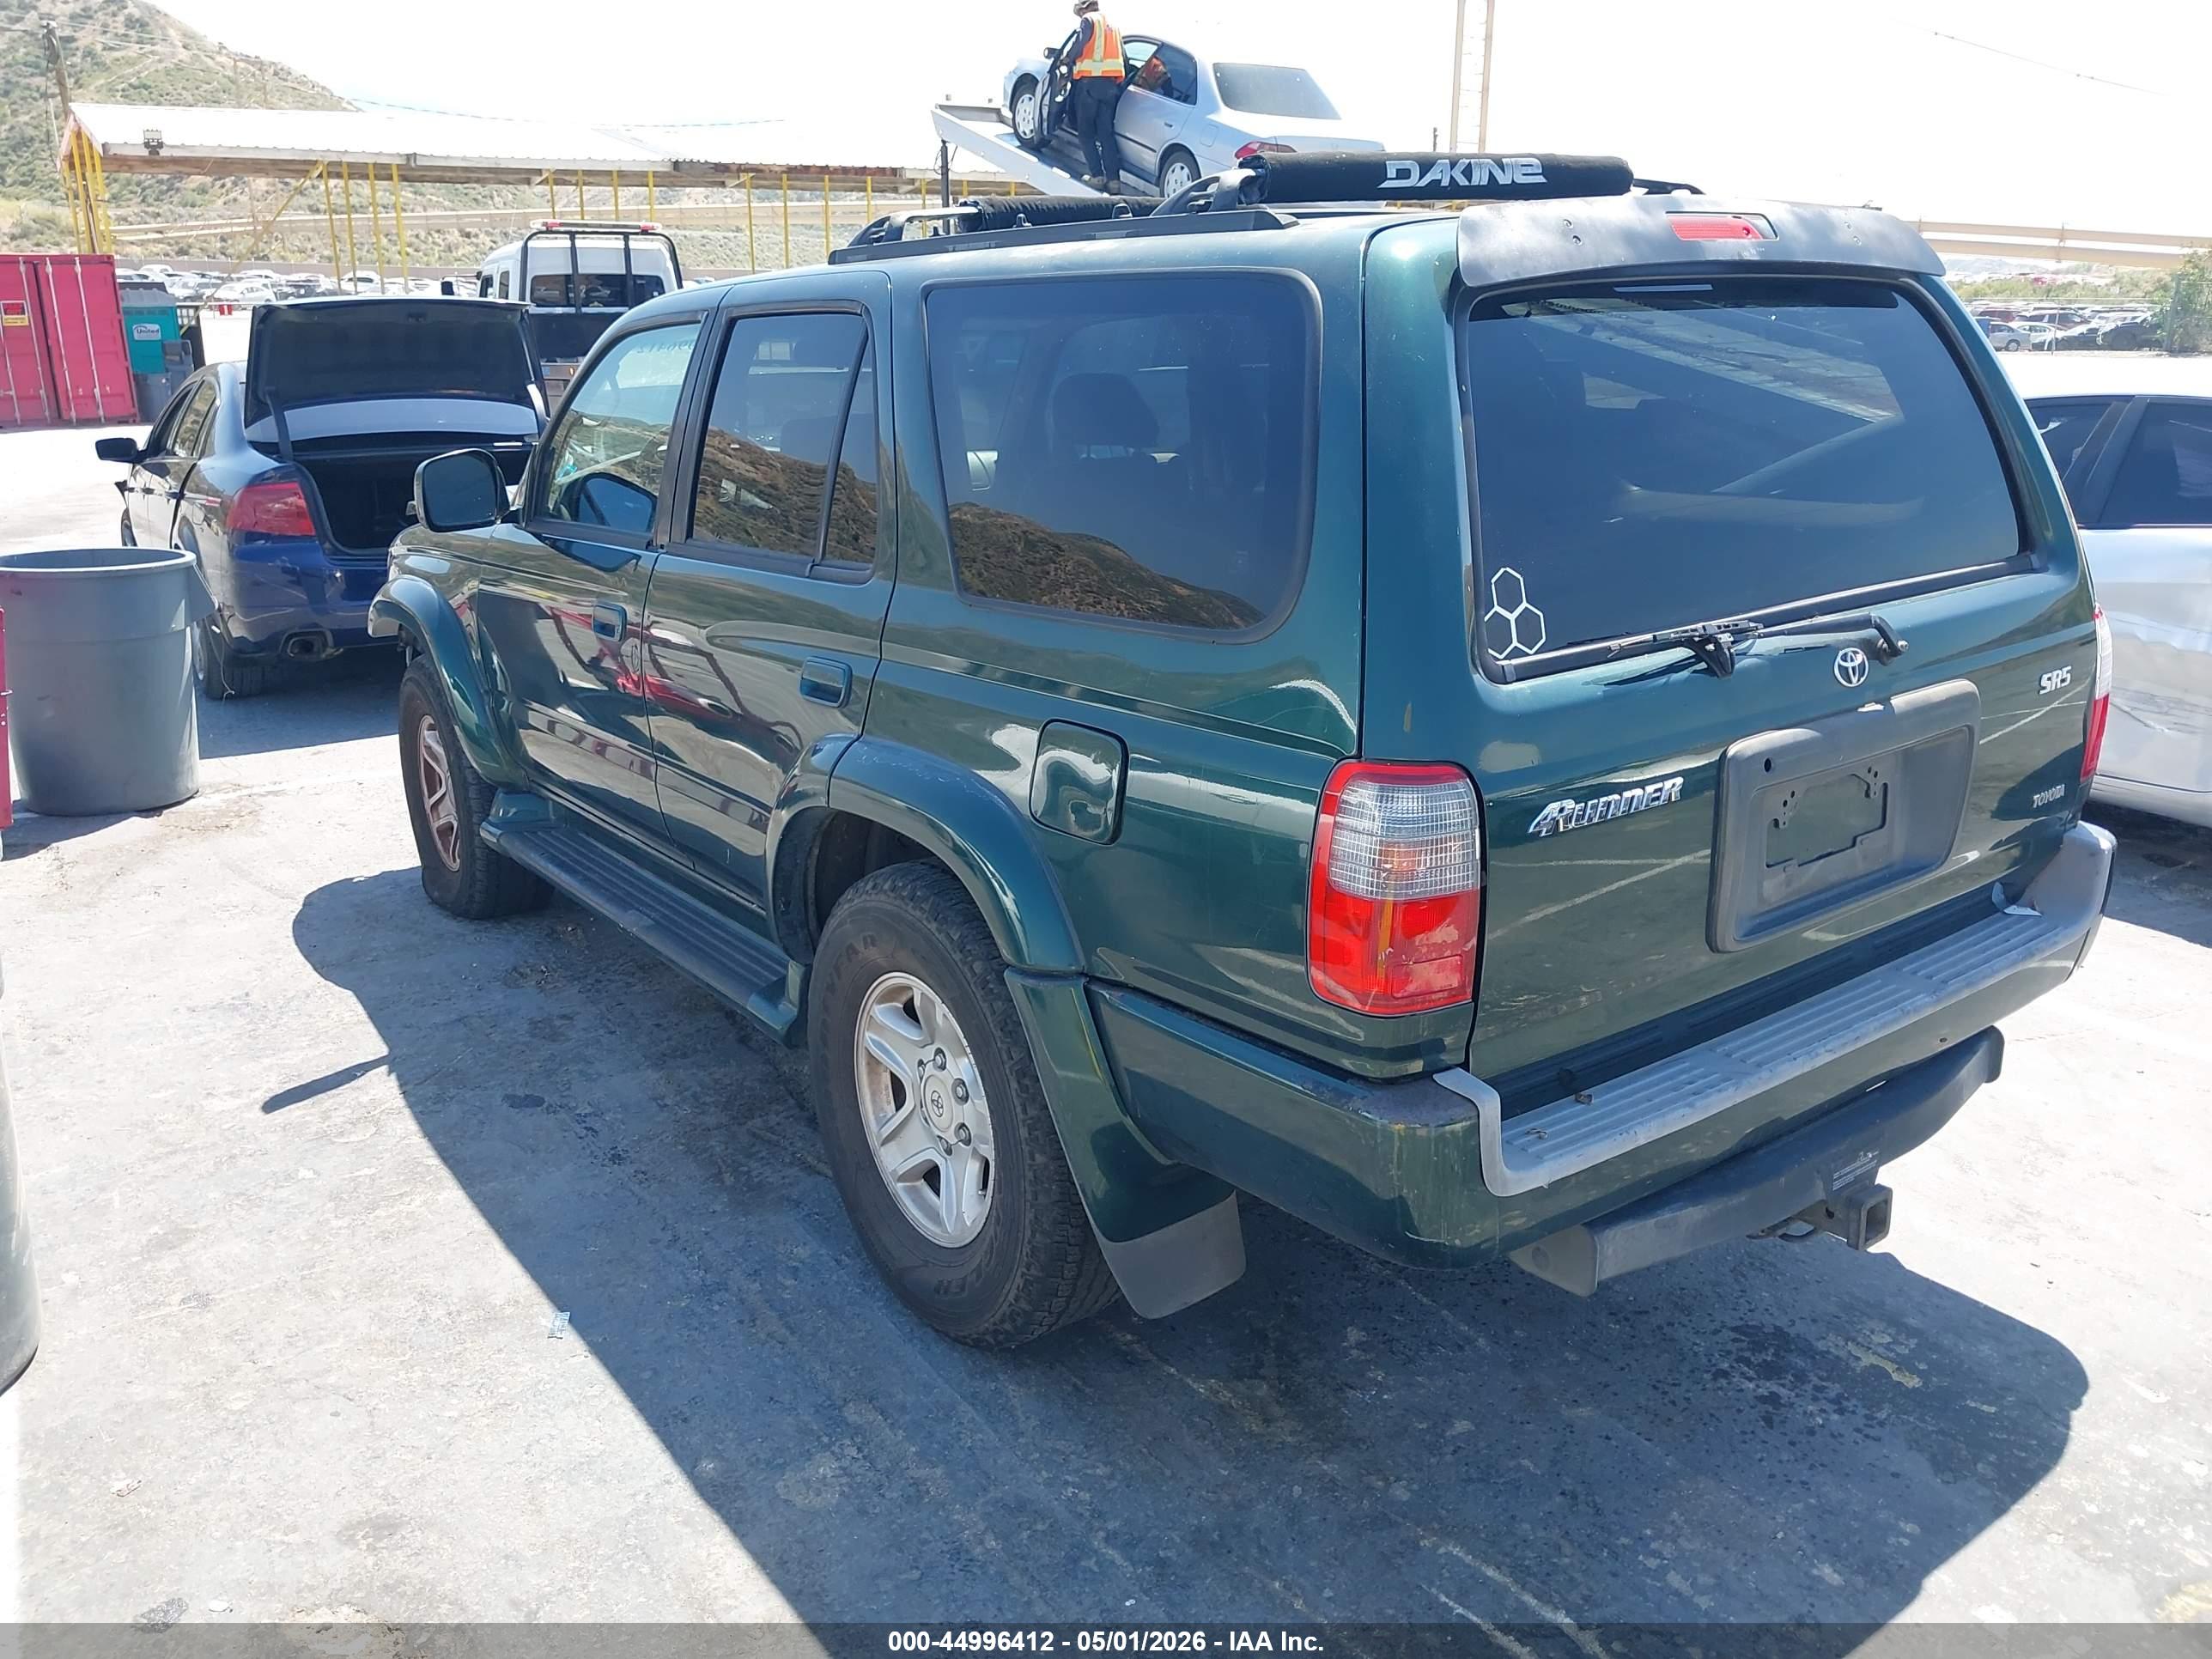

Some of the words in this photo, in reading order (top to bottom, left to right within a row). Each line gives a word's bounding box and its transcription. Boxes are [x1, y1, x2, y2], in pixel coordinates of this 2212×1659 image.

[1376, 158, 1547, 189] DAKINE
[2039, 665, 2072, 695] SR5
[2033, 784, 2065, 809] TOYOTA
